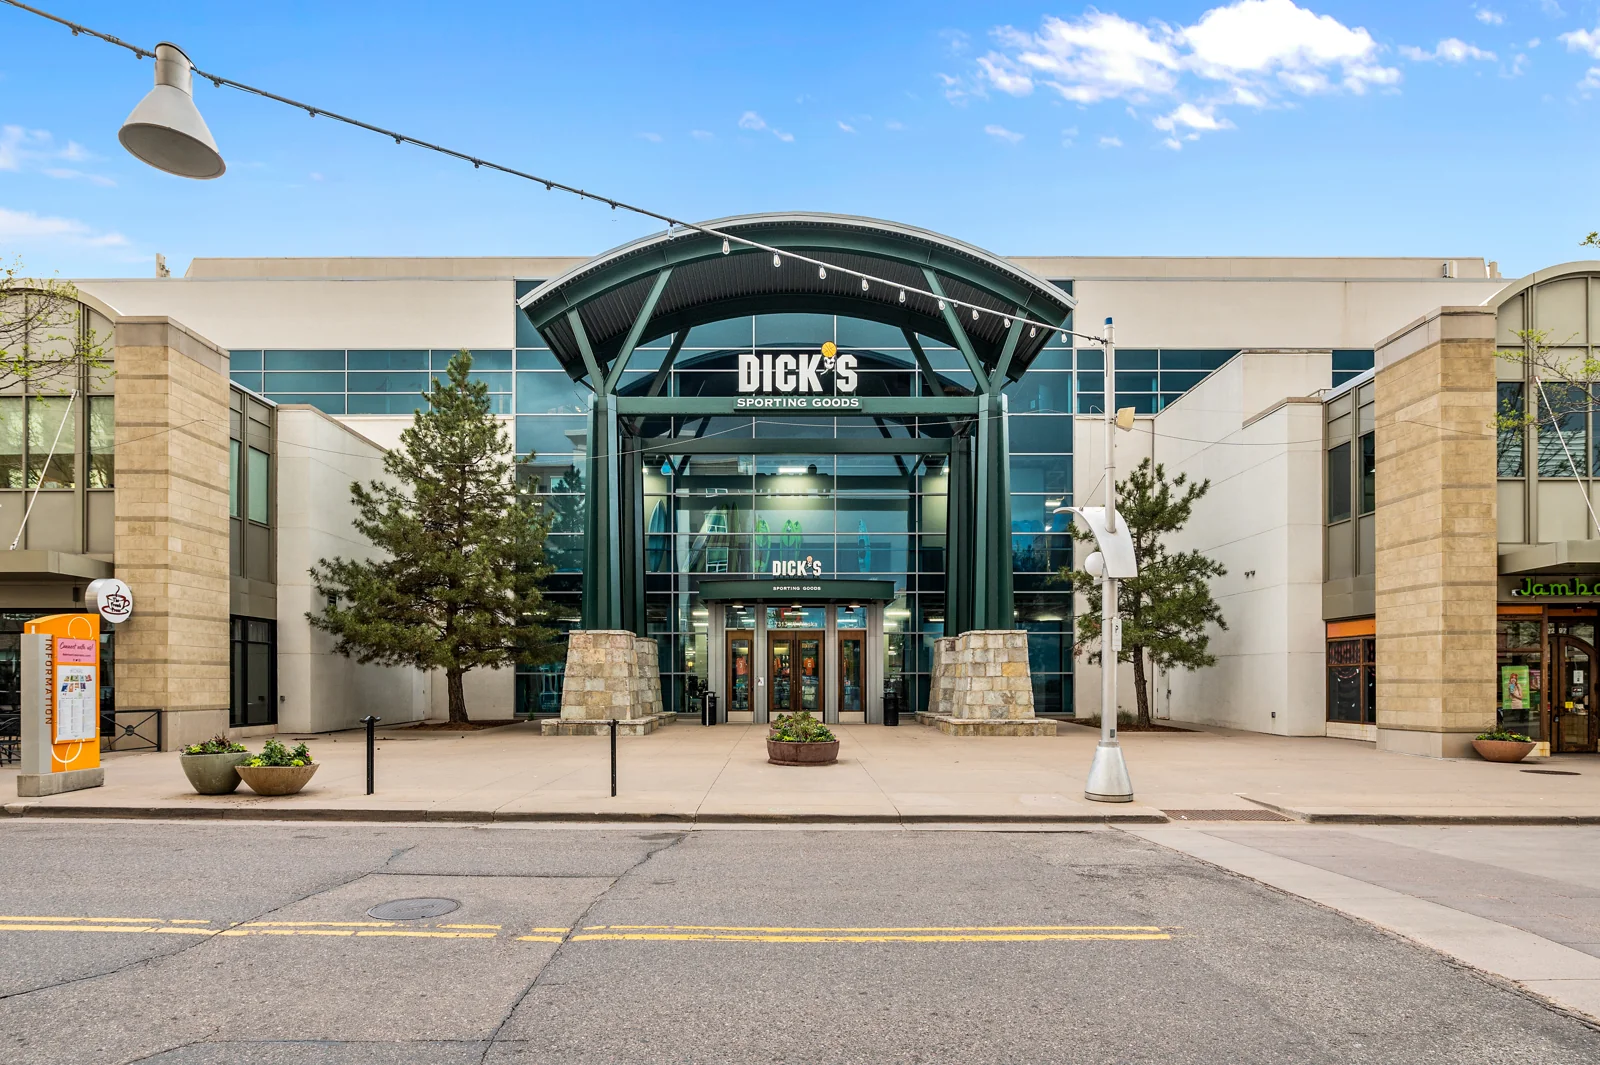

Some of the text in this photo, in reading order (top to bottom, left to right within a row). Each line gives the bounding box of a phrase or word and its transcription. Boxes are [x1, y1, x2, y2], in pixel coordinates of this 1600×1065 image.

[738, 354, 858, 392] DICK'S
[737, 398, 859, 407] SPORTING GOODS
[772, 560, 822, 576] DICK'S
[59, 642, 77, 650] Connect
[45, 637, 53, 725] INFORMATION
